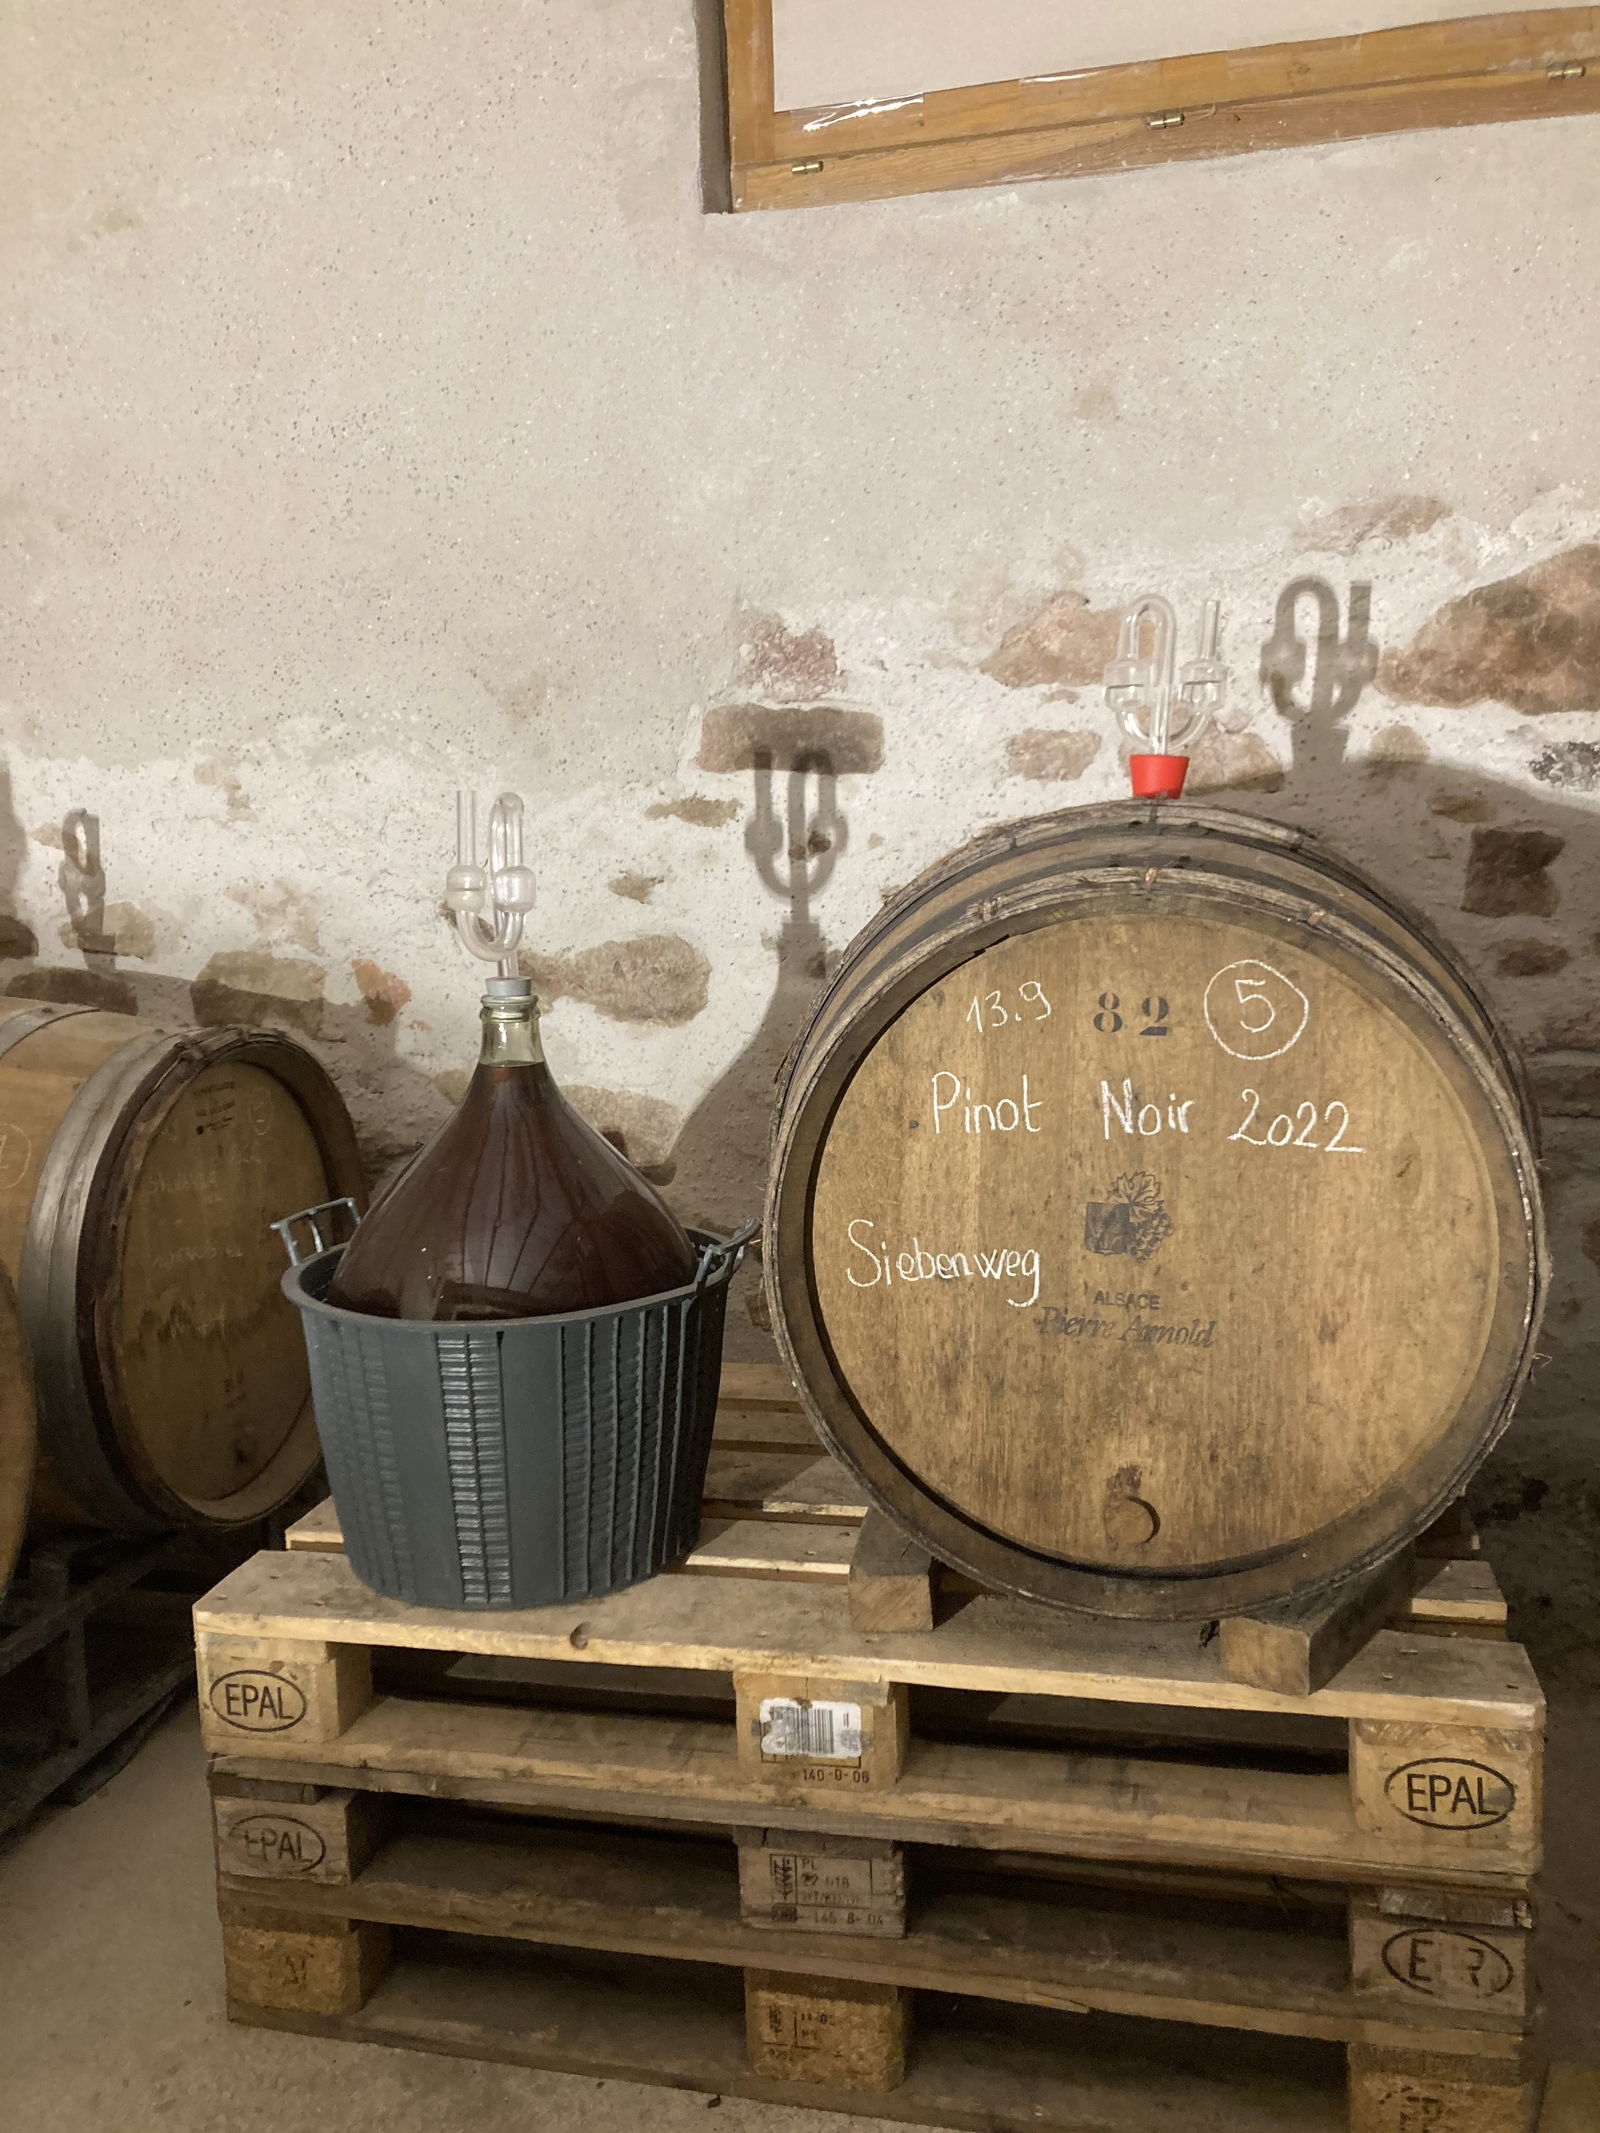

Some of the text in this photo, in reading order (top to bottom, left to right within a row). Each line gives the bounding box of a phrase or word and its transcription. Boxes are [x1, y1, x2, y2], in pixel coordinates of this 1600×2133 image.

[965, 980, 1052, 1033] 13.9
[1093, 991, 1170, 1037] 82
[1234, 979, 1276, 1033] 5
[931, 1070, 1367, 1153] Pinot Noir 2022
[846, 1218, 1041, 1308] Siebenweg
[1034, 1305, 1117, 1339] Pierre
[1093, 1289, 1161, 1311] ALSACE
[224, 1682, 295, 1720] EPAL
[1406, 1773, 1500, 1816] EPAL
[243, 1827, 314, 1863] EPAL
